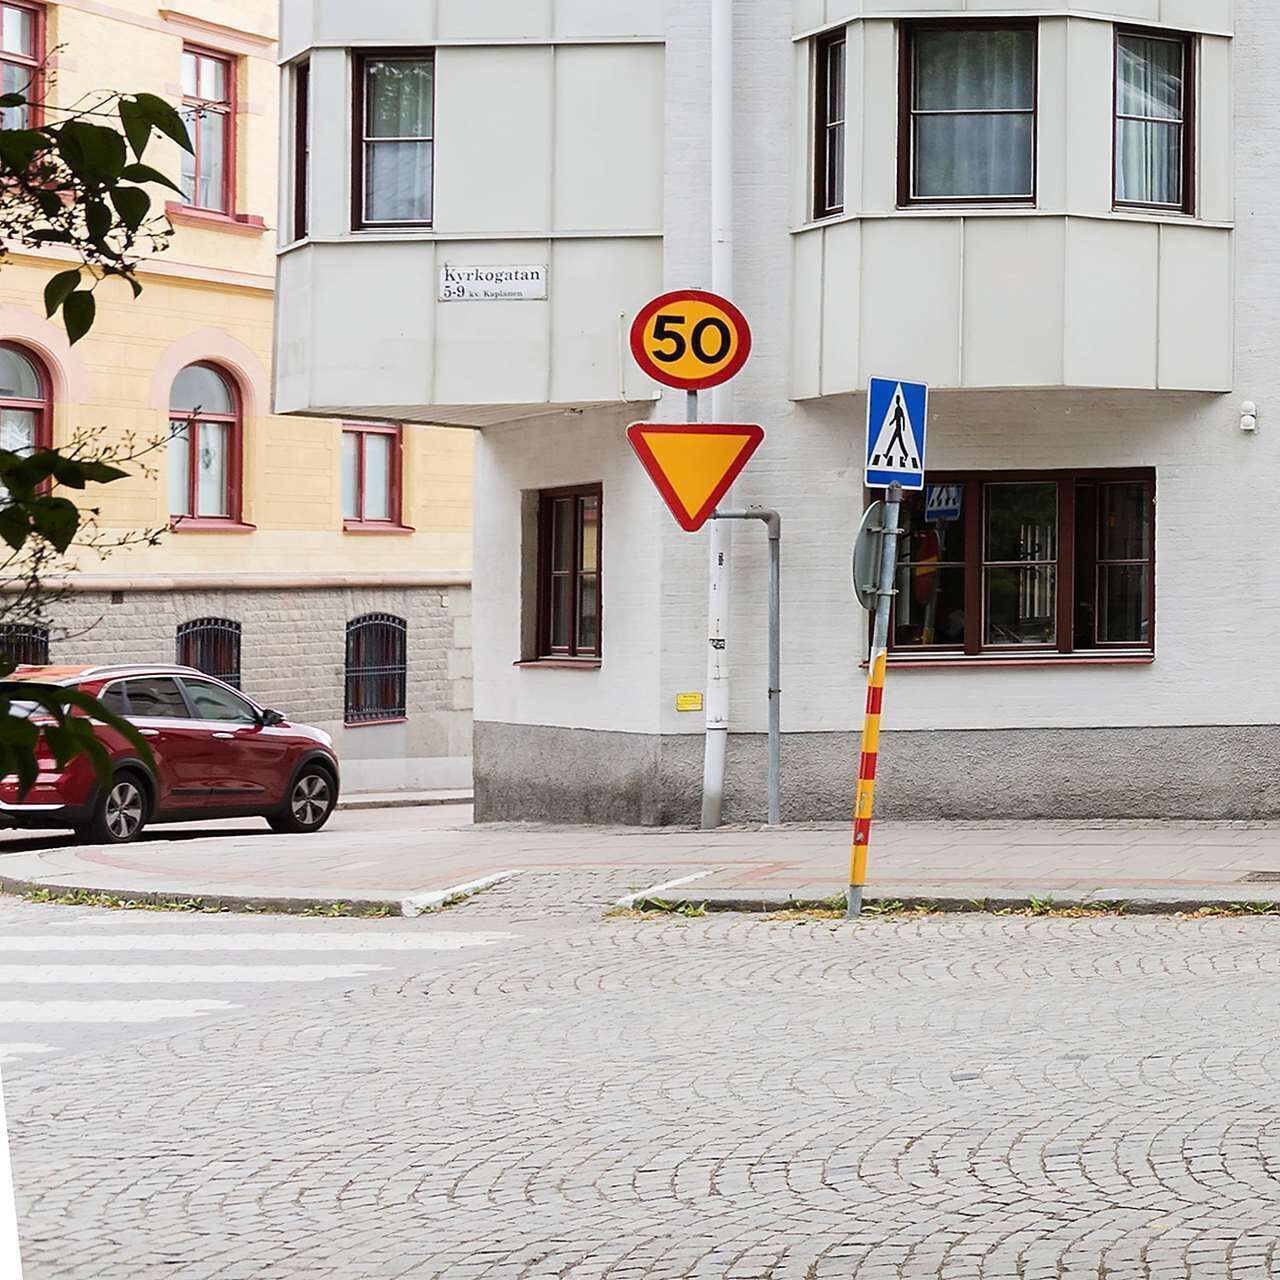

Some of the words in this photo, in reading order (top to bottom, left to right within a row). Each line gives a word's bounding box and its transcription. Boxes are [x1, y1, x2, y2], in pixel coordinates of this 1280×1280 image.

[444, 268, 540, 285] Kyrkogatan
[443, 285, 465, 298] 5-9
[652, 315, 731, 364] 50
